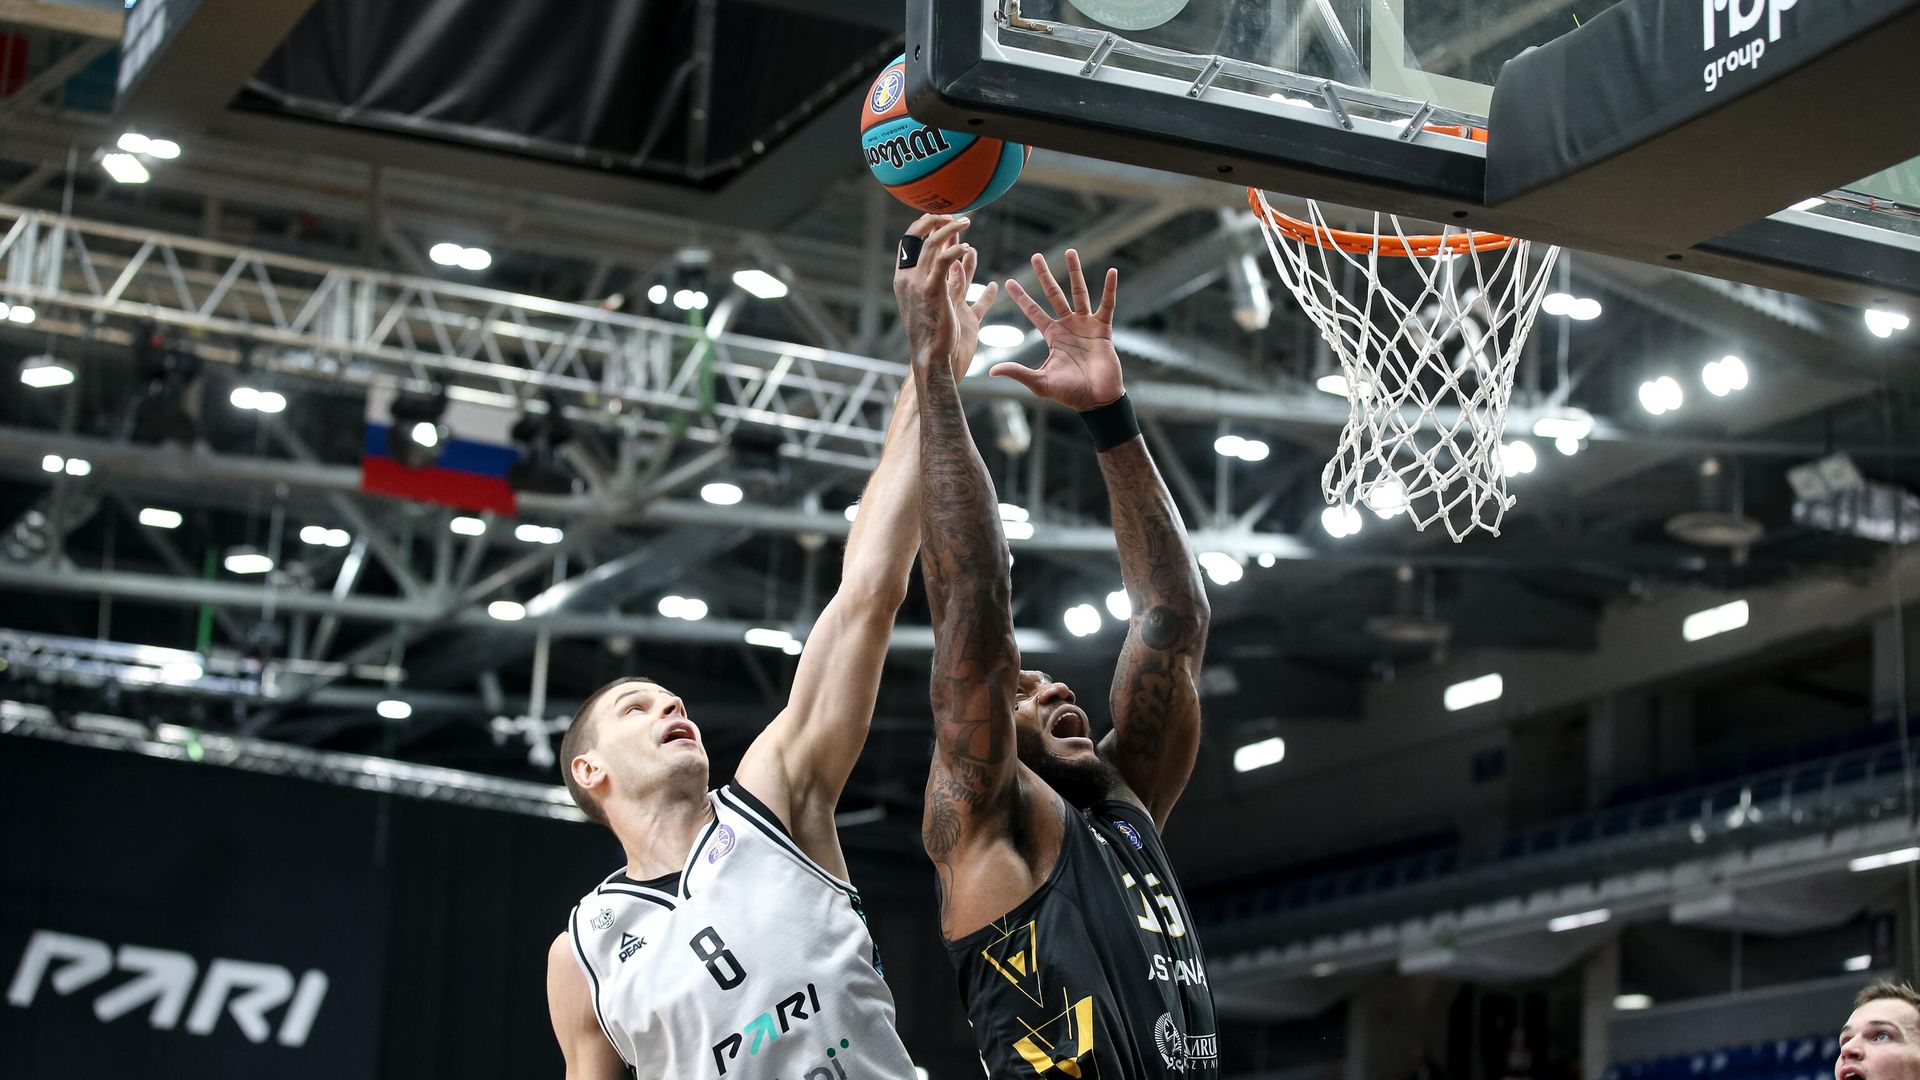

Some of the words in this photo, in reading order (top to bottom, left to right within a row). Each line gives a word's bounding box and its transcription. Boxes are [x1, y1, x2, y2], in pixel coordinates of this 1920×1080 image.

[1703, 38, 1765, 92] group
[864, 124, 951, 169] Wilson
[618, 936, 648, 963] PEAK
[689, 926, 747, 991] 8
[1148, 953, 1209, 992] SANA
[6, 928, 330, 1048] PARI
[712, 982, 822, 1077] PARI
